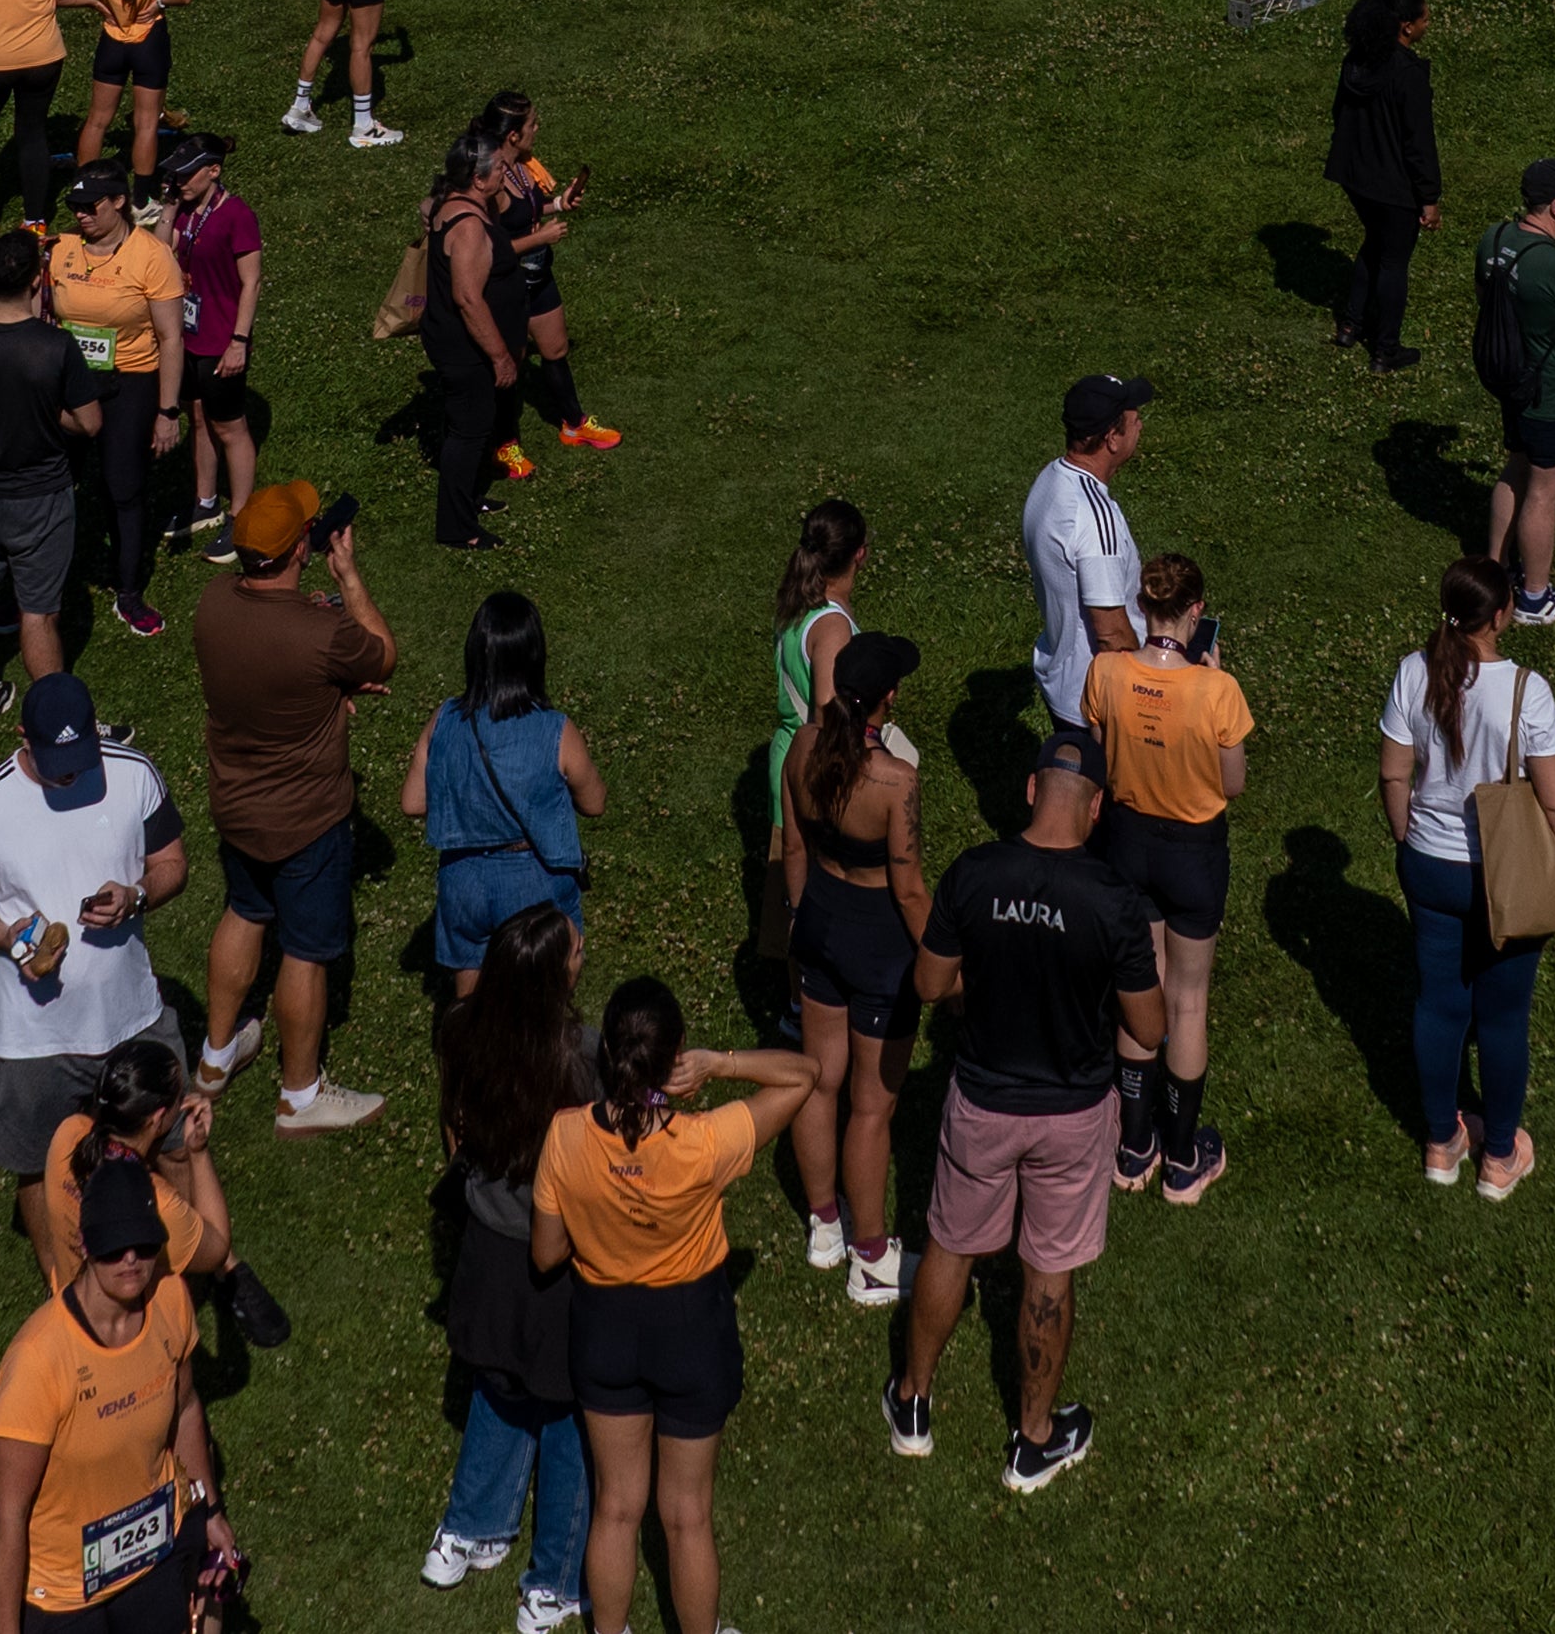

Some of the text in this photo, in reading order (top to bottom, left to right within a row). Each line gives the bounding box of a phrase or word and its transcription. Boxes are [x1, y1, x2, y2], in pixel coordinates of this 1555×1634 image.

[78, 339, 106, 354] 556
[1132, 683, 1163, 698] VENUS
[992, 897, 1066, 933] LAURA
[96, 1391, 137, 1420] VENUS
[111, 1514, 160, 1556] 1263
